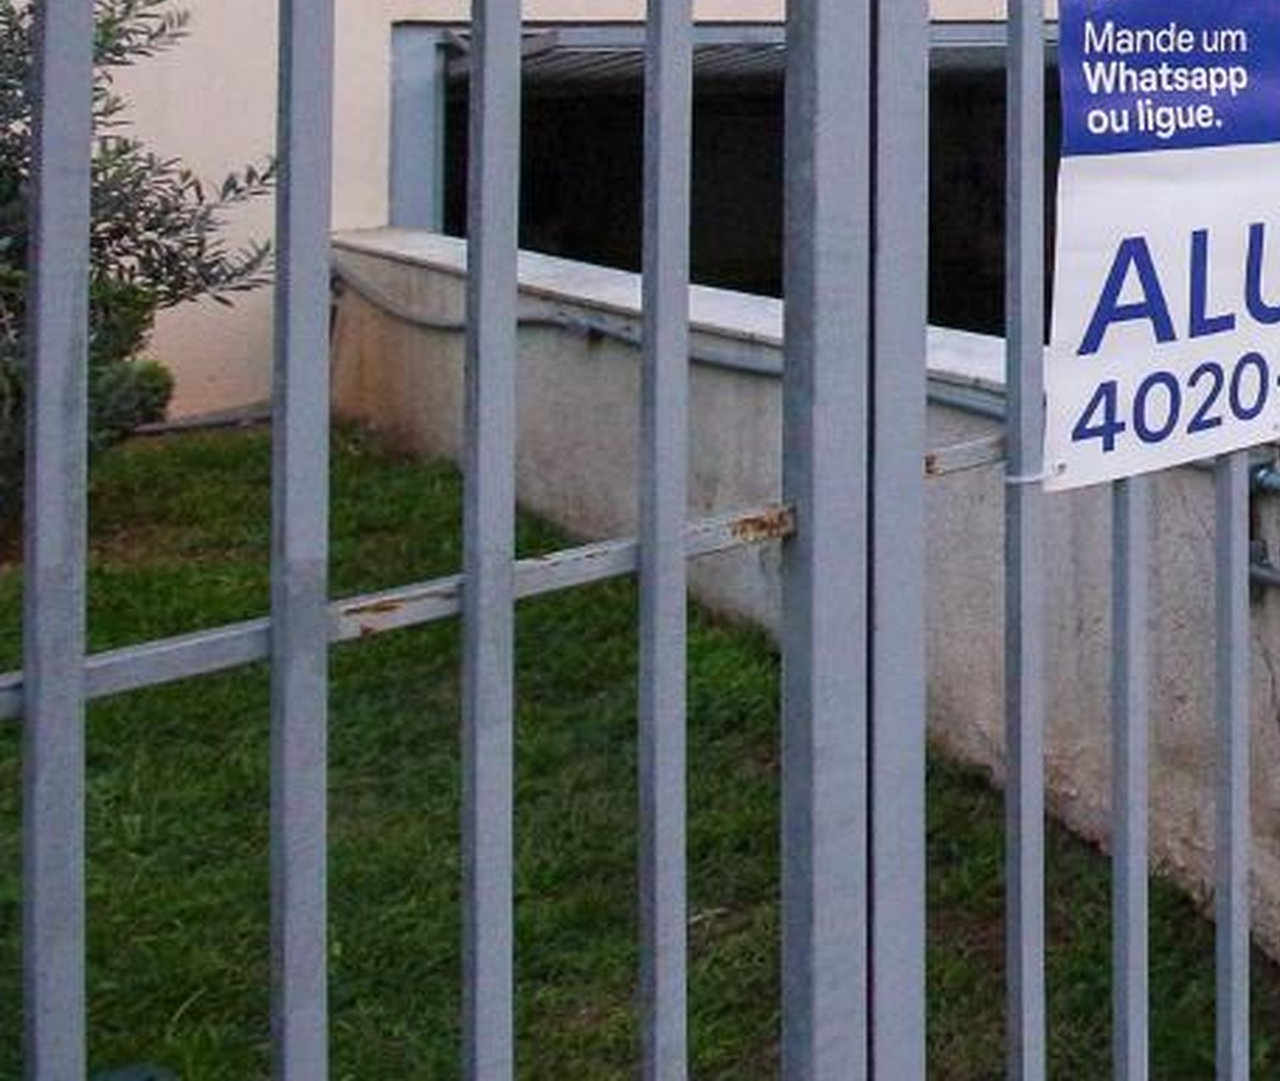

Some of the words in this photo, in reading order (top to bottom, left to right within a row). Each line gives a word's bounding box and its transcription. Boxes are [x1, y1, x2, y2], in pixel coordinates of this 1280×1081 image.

[1083, 20, 1195, 55] Mande
[1202, 29, 1248, 53] um
[1082, 60, 1249, 97] Whatsapp
[1087, 108, 1130, 135] ou
[1136, 98, 1223, 139] ligue.
